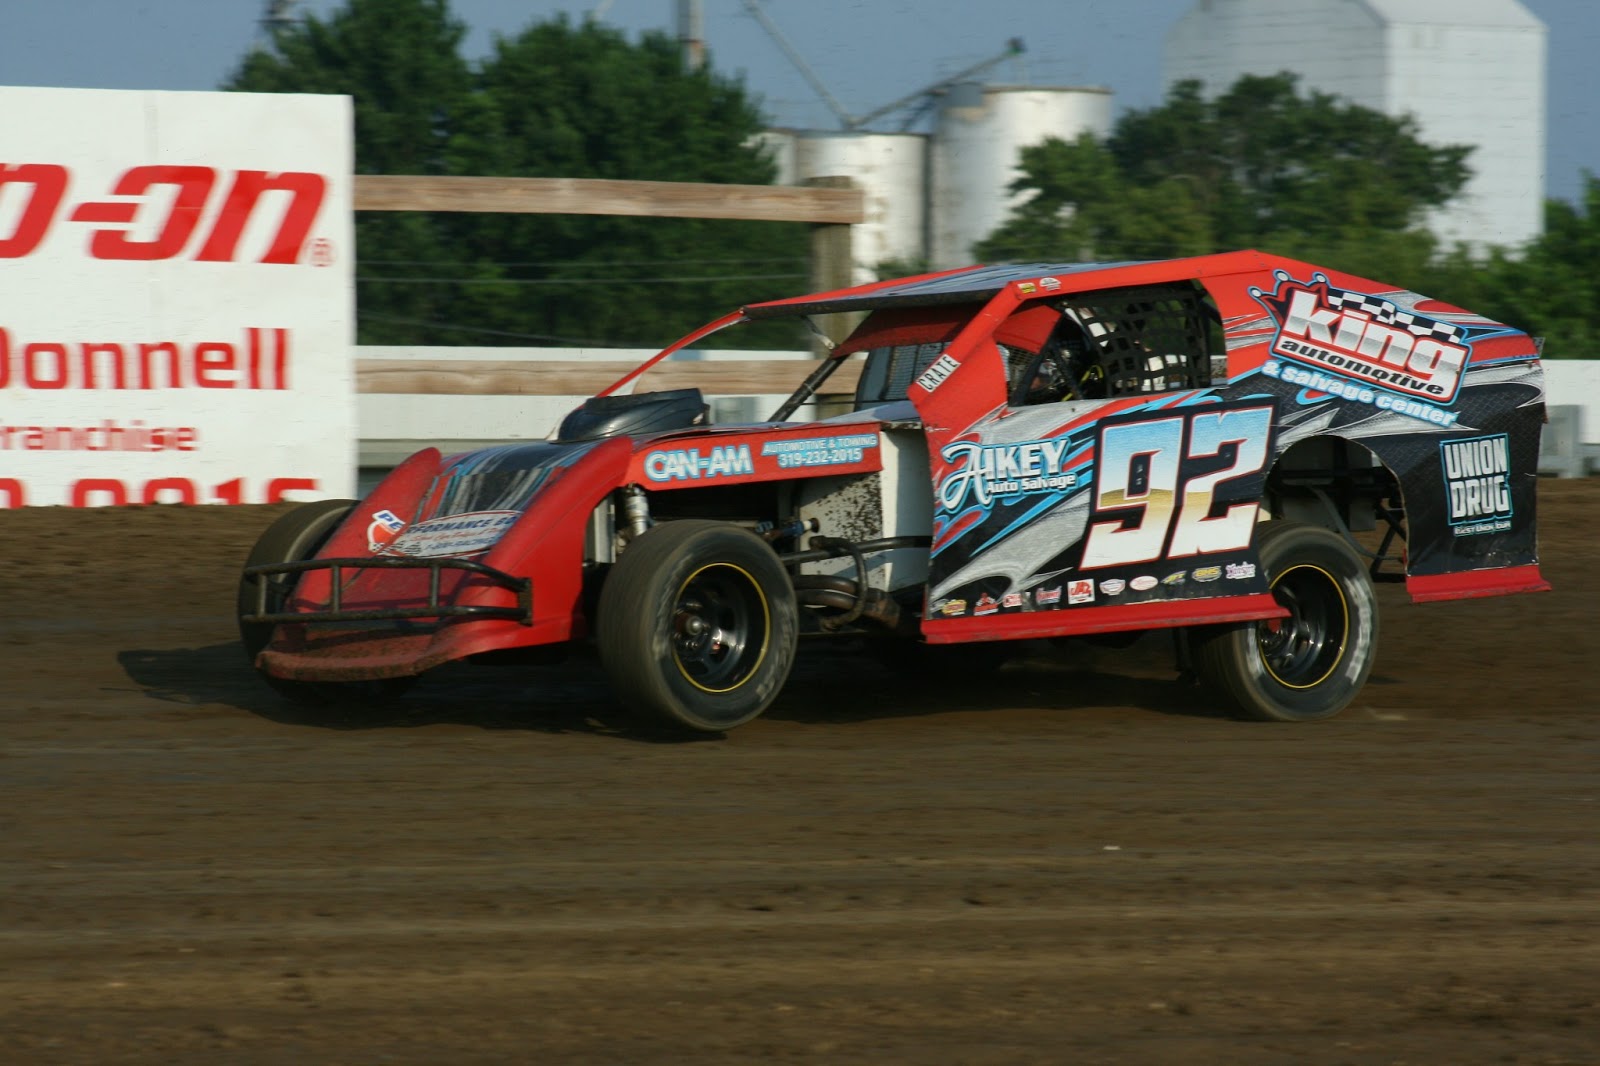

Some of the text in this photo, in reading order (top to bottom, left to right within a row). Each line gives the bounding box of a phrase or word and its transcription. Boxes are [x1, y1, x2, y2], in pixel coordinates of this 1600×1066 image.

[0, 326, 290, 391] onnell
[917, 355, 960, 391] CRATE
[1281, 338, 1445, 396] automotive
[1261, 360, 1461, 427] & salvage center
[0, 419, 198, 452] ranchise
[762, 439, 827, 454] AUTOMOTIVE
[837, 435, 878, 447] TOWING
[644, 445, 754, 482] CAN-AM
[779, 447, 862, 467] 319-232-2015
[1444, 437, 1507, 479] UNION
[985, 475, 1076, 494] Auto Salvage
[1078, 405, 1272, 572] 92
[1450, 475, 1510, 518] DRUG
